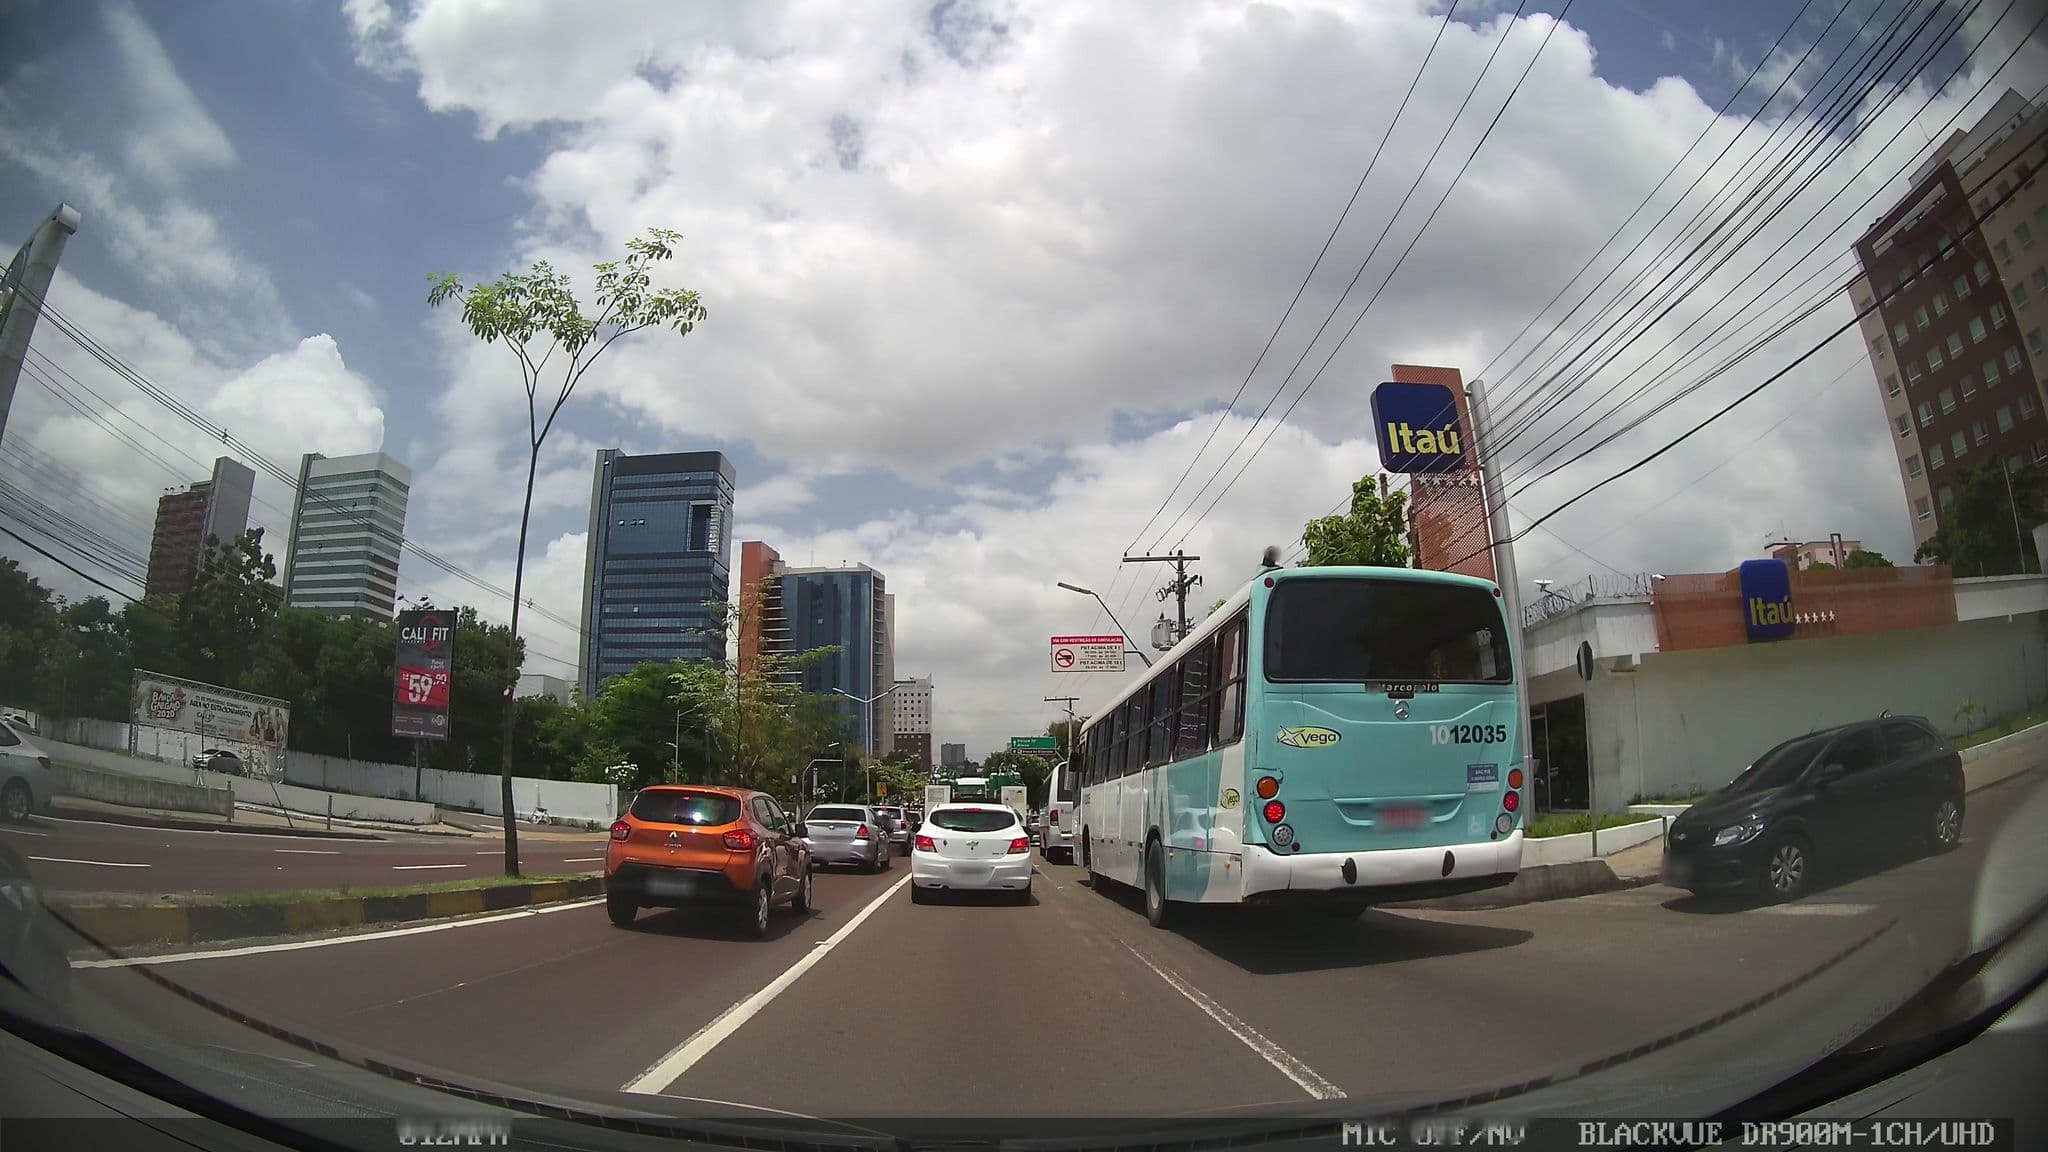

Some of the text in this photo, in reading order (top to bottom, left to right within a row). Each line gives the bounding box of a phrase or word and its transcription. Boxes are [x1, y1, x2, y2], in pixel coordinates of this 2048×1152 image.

[1387, 422, 1461, 454] Itaú
[1749, 595, 1794, 625] Itaú
[401, 626, 449, 641] CALI FIT
[156, 710, 175, 718] 2020
[1300, 733, 1337, 745] Vega
